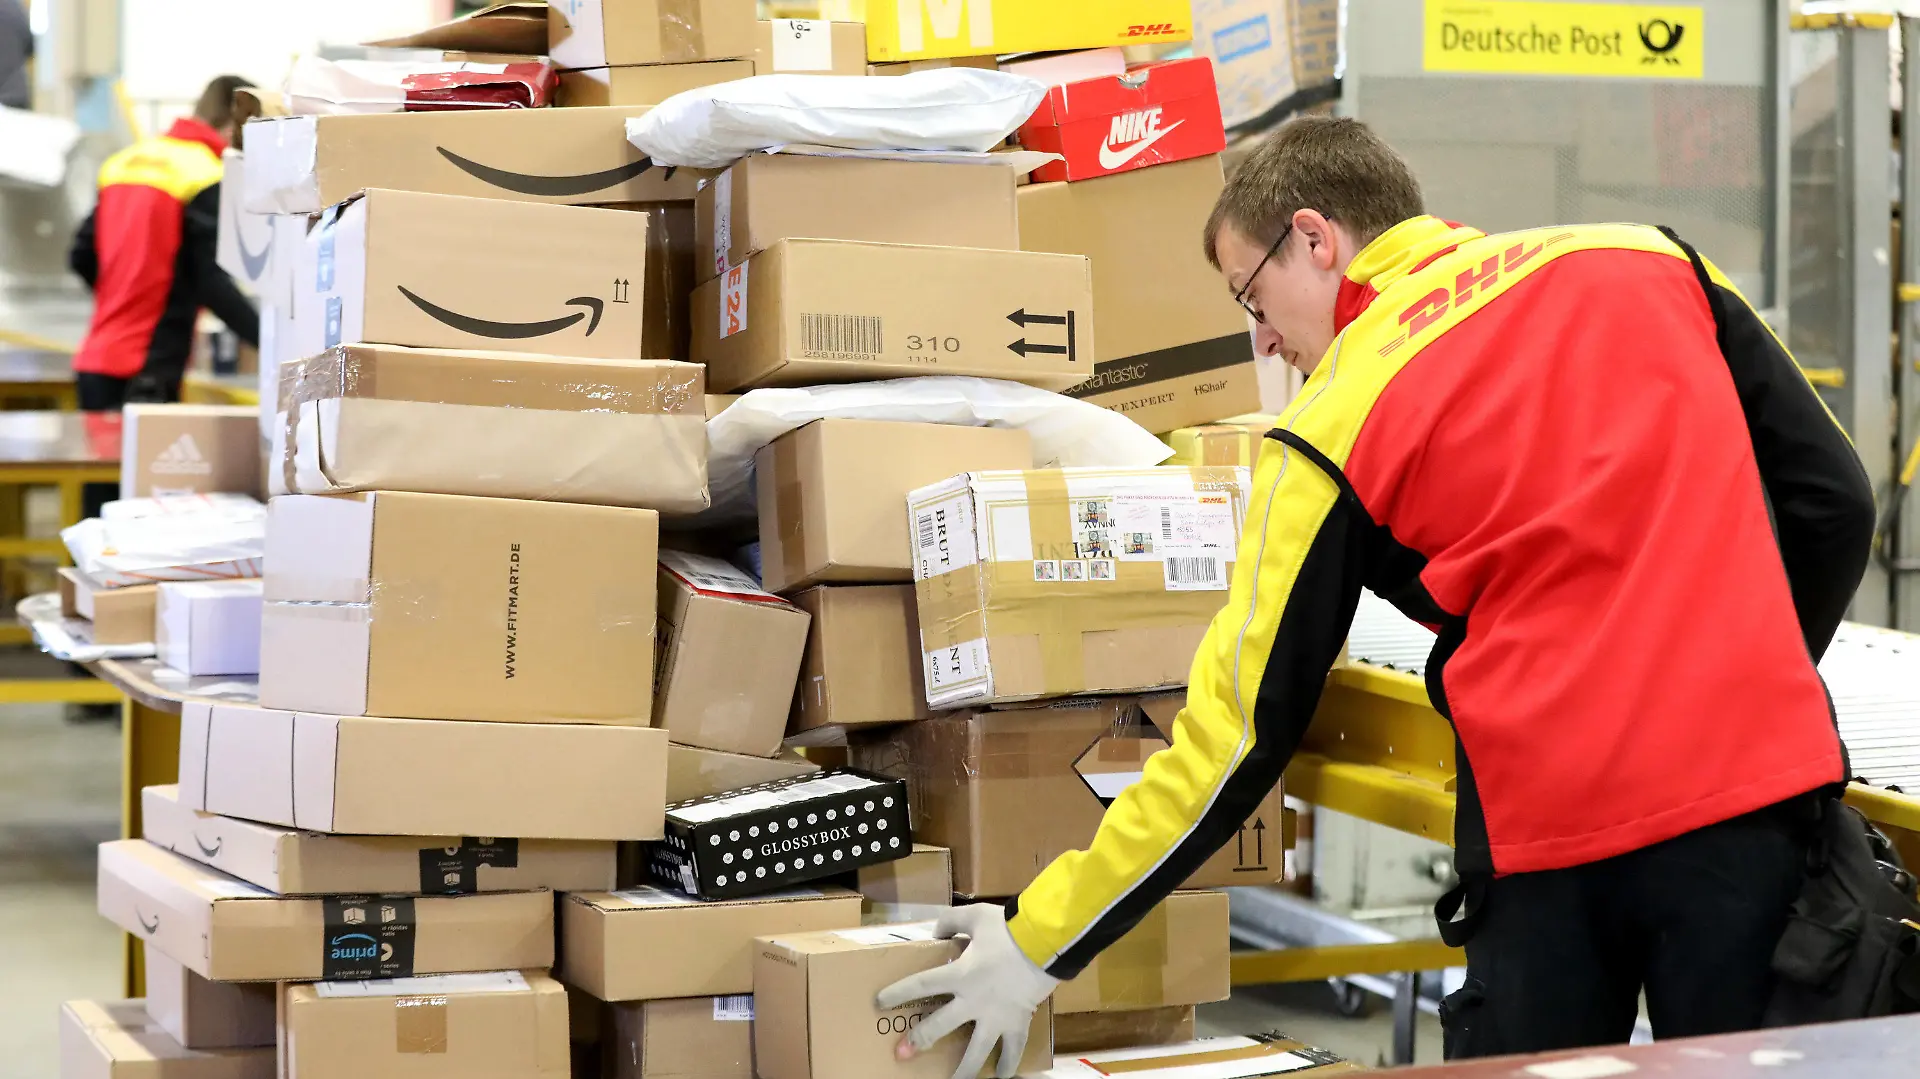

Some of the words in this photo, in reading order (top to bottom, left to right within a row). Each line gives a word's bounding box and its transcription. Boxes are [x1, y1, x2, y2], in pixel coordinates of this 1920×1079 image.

[1127, 23, 1176, 37] DHL
[1441, 22, 1562, 54] Deutsche
[1570, 26, 1622, 56] Post
[1108, 107, 1163, 146] NIKE
[1398, 242, 1543, 339] DHL
[906, 335, 960, 352] 310
[907, 355, 938, 364] 1114
[1121, 392, 1175, 412] EXPERT
[936, 508, 950, 565] BRUT
[505, 543, 521, 680] WWW.FITMART.DE
[761, 826, 851, 856] GLOSSYBOX
[331, 943, 377, 962] prime
[876, 1012, 924, 1035] DOO
